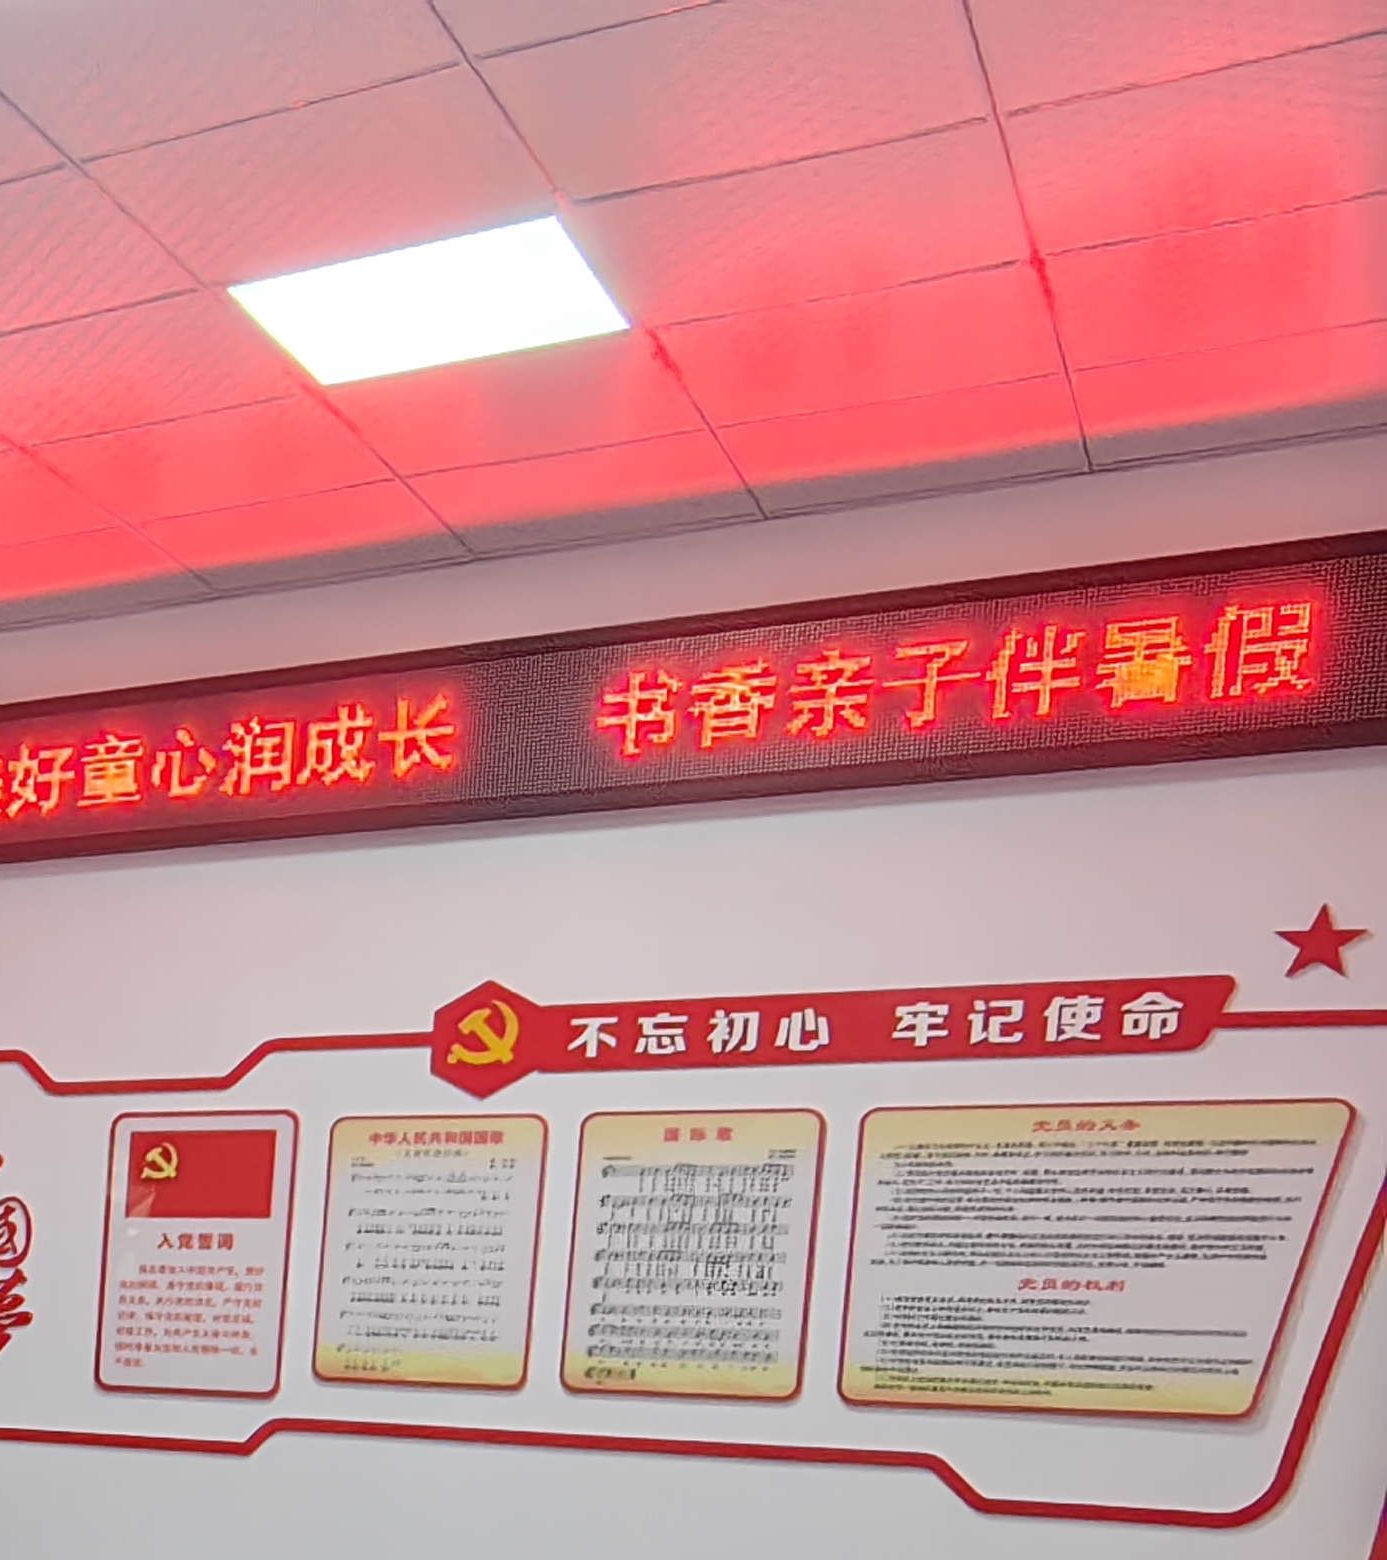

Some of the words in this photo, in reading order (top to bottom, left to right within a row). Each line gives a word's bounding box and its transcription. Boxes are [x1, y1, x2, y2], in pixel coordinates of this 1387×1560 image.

[596, 600, 1315, 758] 书香亲子伴暑假
[566, 1007, 831, 1058] 不忘初心
[892, 991, 1184, 1048] 牢记使命
